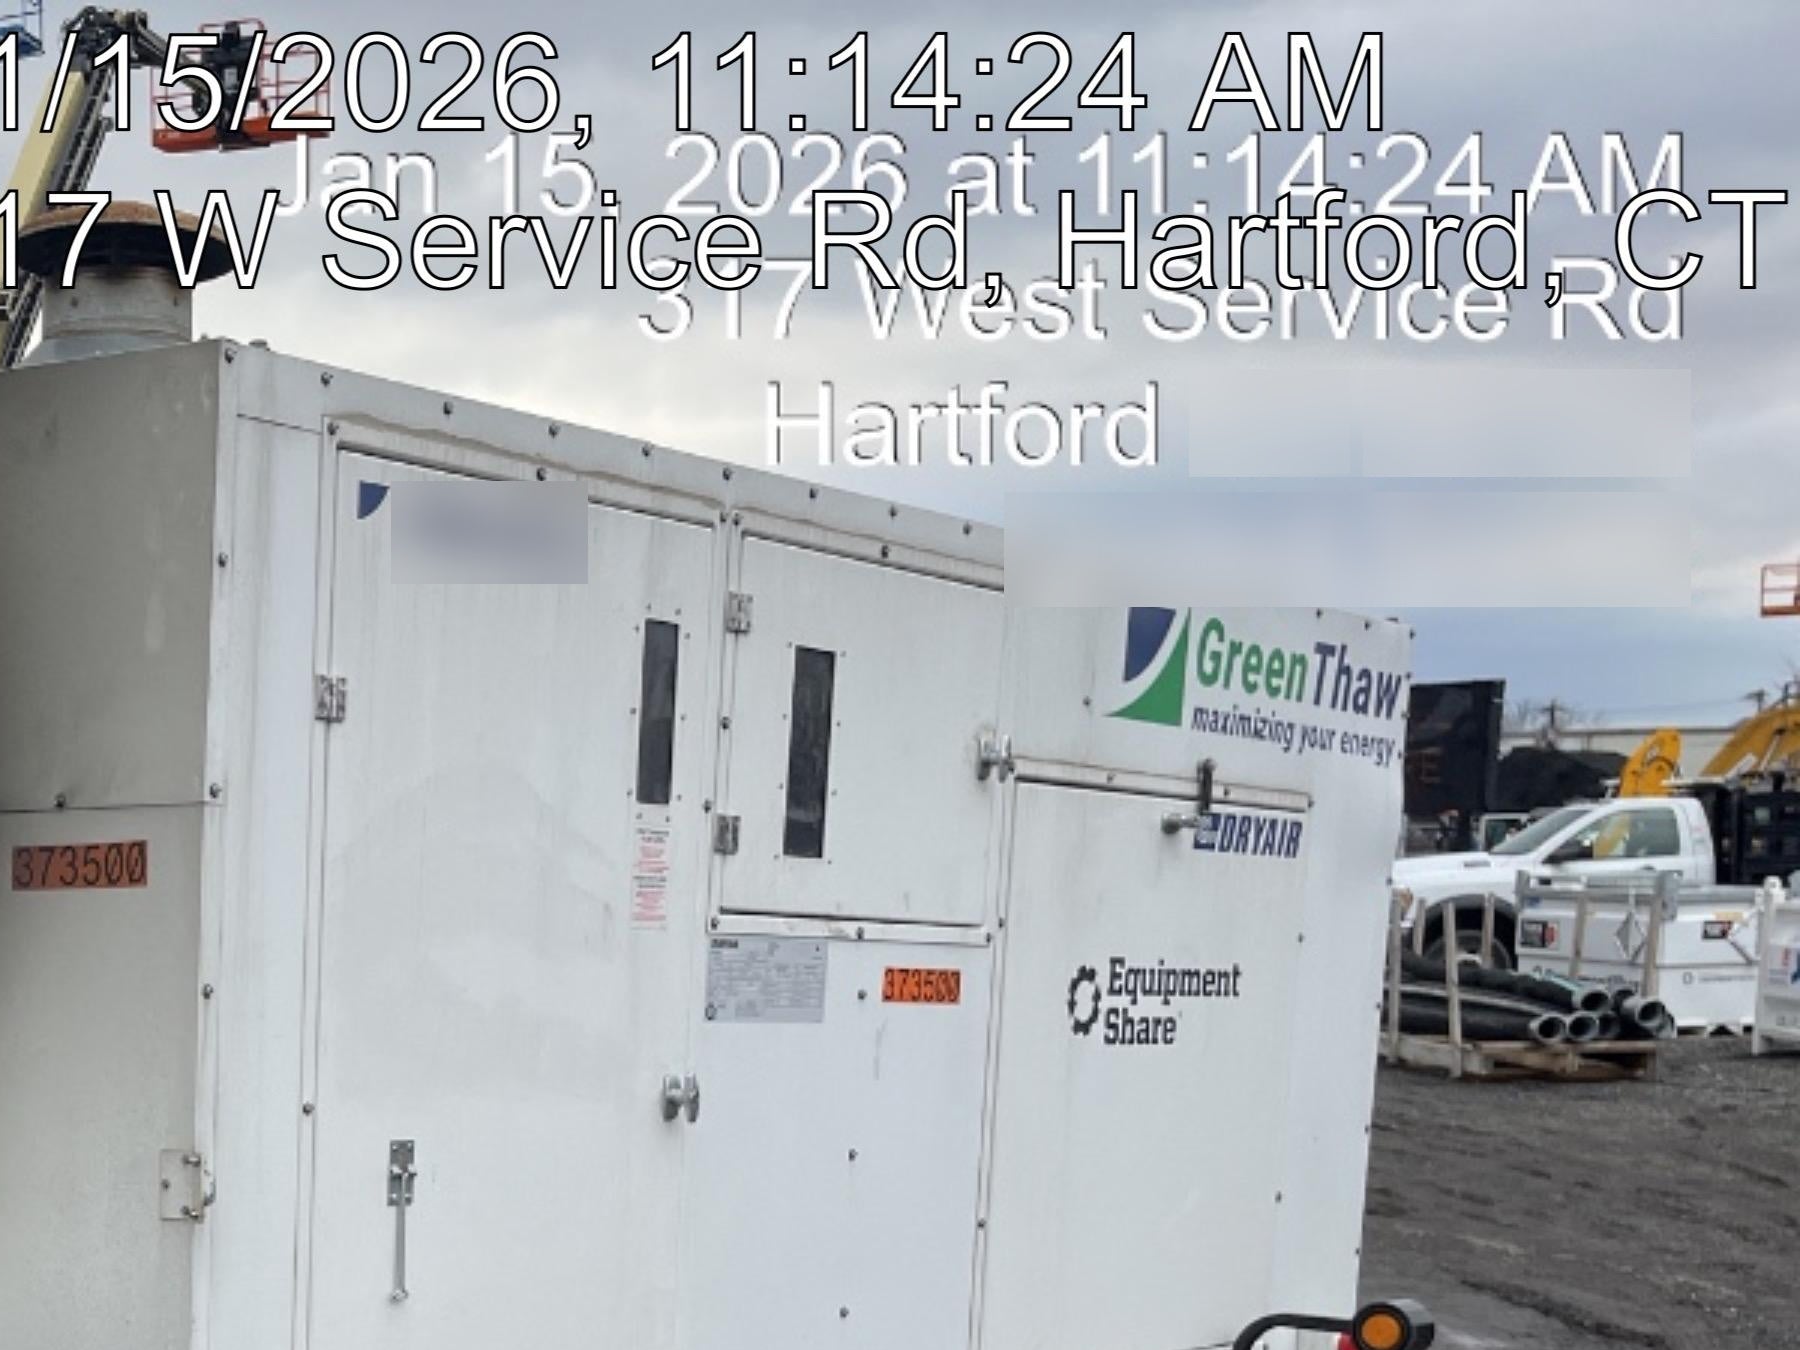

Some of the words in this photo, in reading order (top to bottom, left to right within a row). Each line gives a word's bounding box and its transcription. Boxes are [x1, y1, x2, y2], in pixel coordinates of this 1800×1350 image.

[1191, 704, 1294, 752] maximizing
[1298, 725, 1336, 755] your
[1340, 729, 1396, 767] energy
[1217, 813, 1304, 859] DRYAIR
[13, 841, 146, 887] 373500
[883, 967, 962, 1003] 373500
[1106, 956, 1243, 1006] Equipment
[1103, 1007, 1177, 1045] Share
